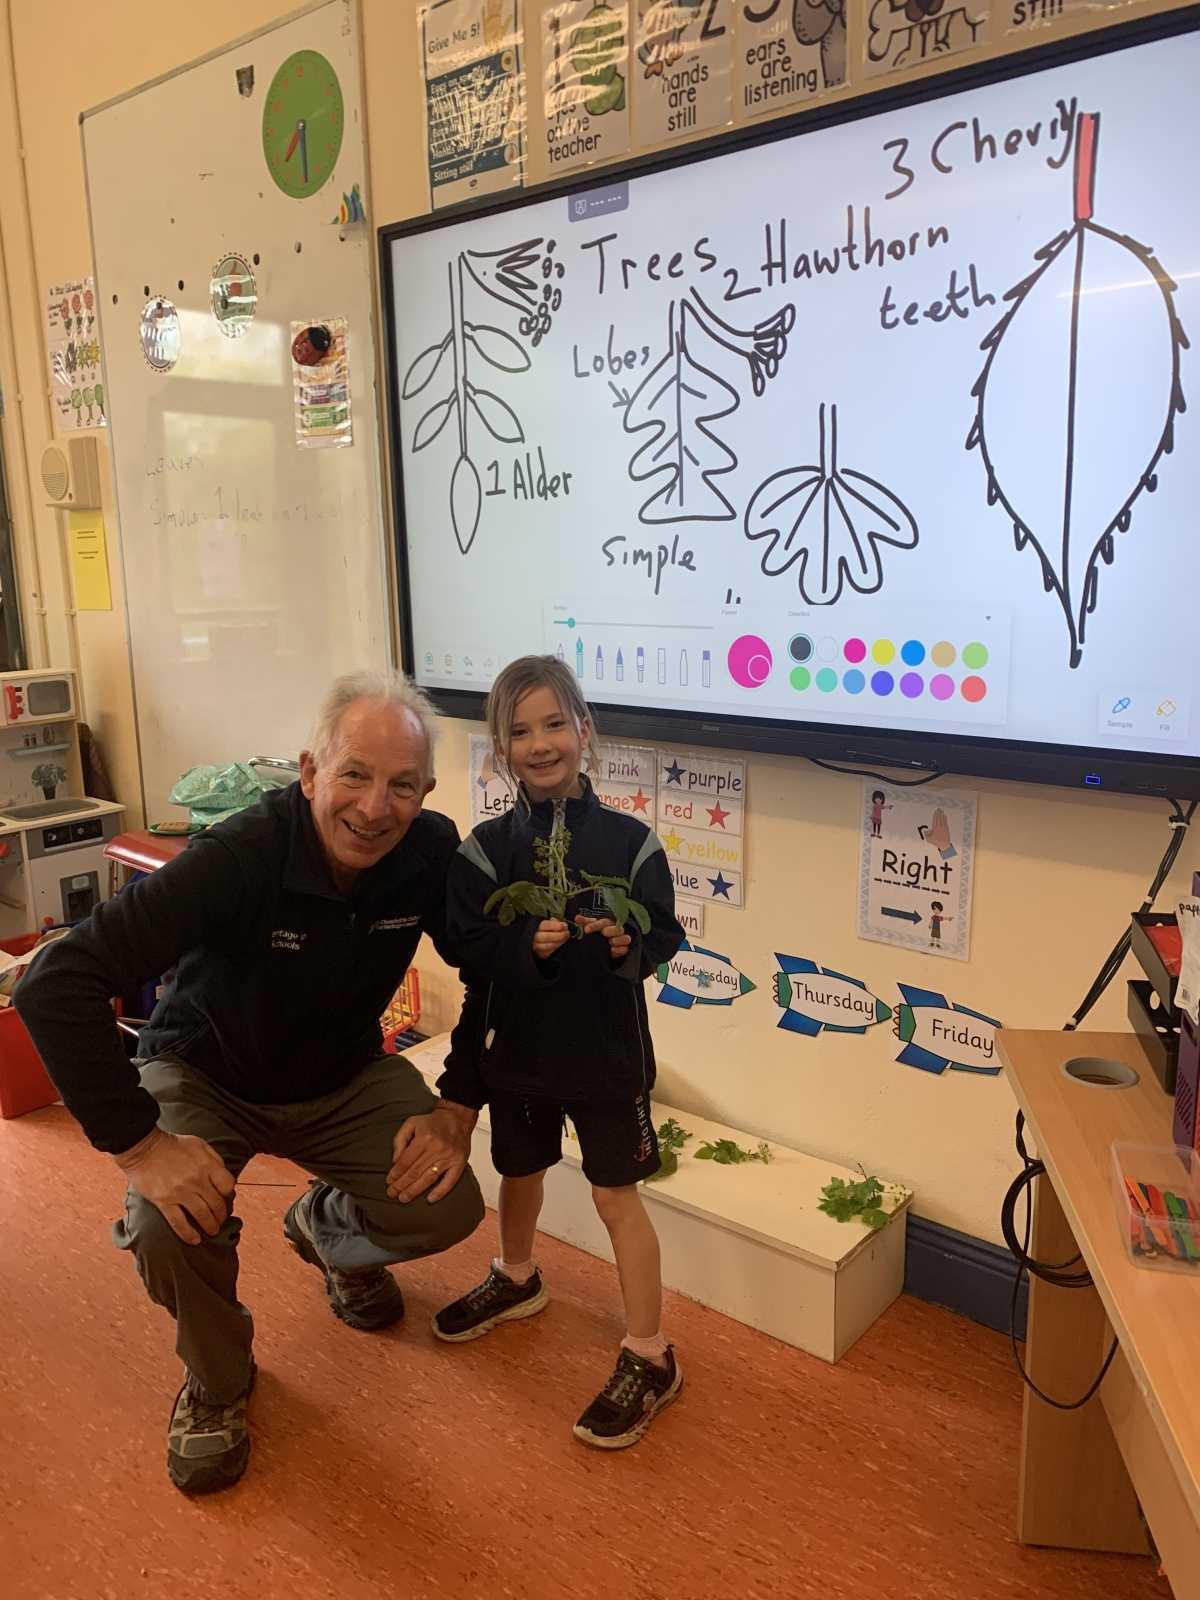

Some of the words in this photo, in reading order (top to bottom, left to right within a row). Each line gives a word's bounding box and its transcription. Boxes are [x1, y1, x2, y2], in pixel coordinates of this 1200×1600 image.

[428, 37, 449, 53] Give
[452, 29, 467, 44] Me
[746, 38, 786, 65] ears
[662, 63, 709, 94] hands
[761, 55, 793, 80] are
[668, 87, 696, 108] are
[744, 68, 817, 106] listening
[668, 105, 696, 131] still
[548, 134, 601, 163] teacher
[884, 137, 916, 200] 3
[581, 233, 717, 294] Trees
[724, 269, 762, 301] 2
[761, 204, 949, 287] Hawthorn
[880, 263, 997, 329] teeth
[573, 324, 650, 378] Lobes
[485, 460, 506, 496] 1
[513, 446, 573, 500] Alder
[601, 534, 697, 595] Simple
[607, 758, 640, 778] pink
[688, 771, 742, 794] purple
[665, 801, 693, 819] red
[686, 839, 738, 862] yellow
[670, 867, 699, 889] lue
[882, 848, 953, 886] Right
[669, 960, 738, 990] Wedsday
[793, 981, 875, 1021] Thursday
[932, 1018, 994, 1058] Friday
